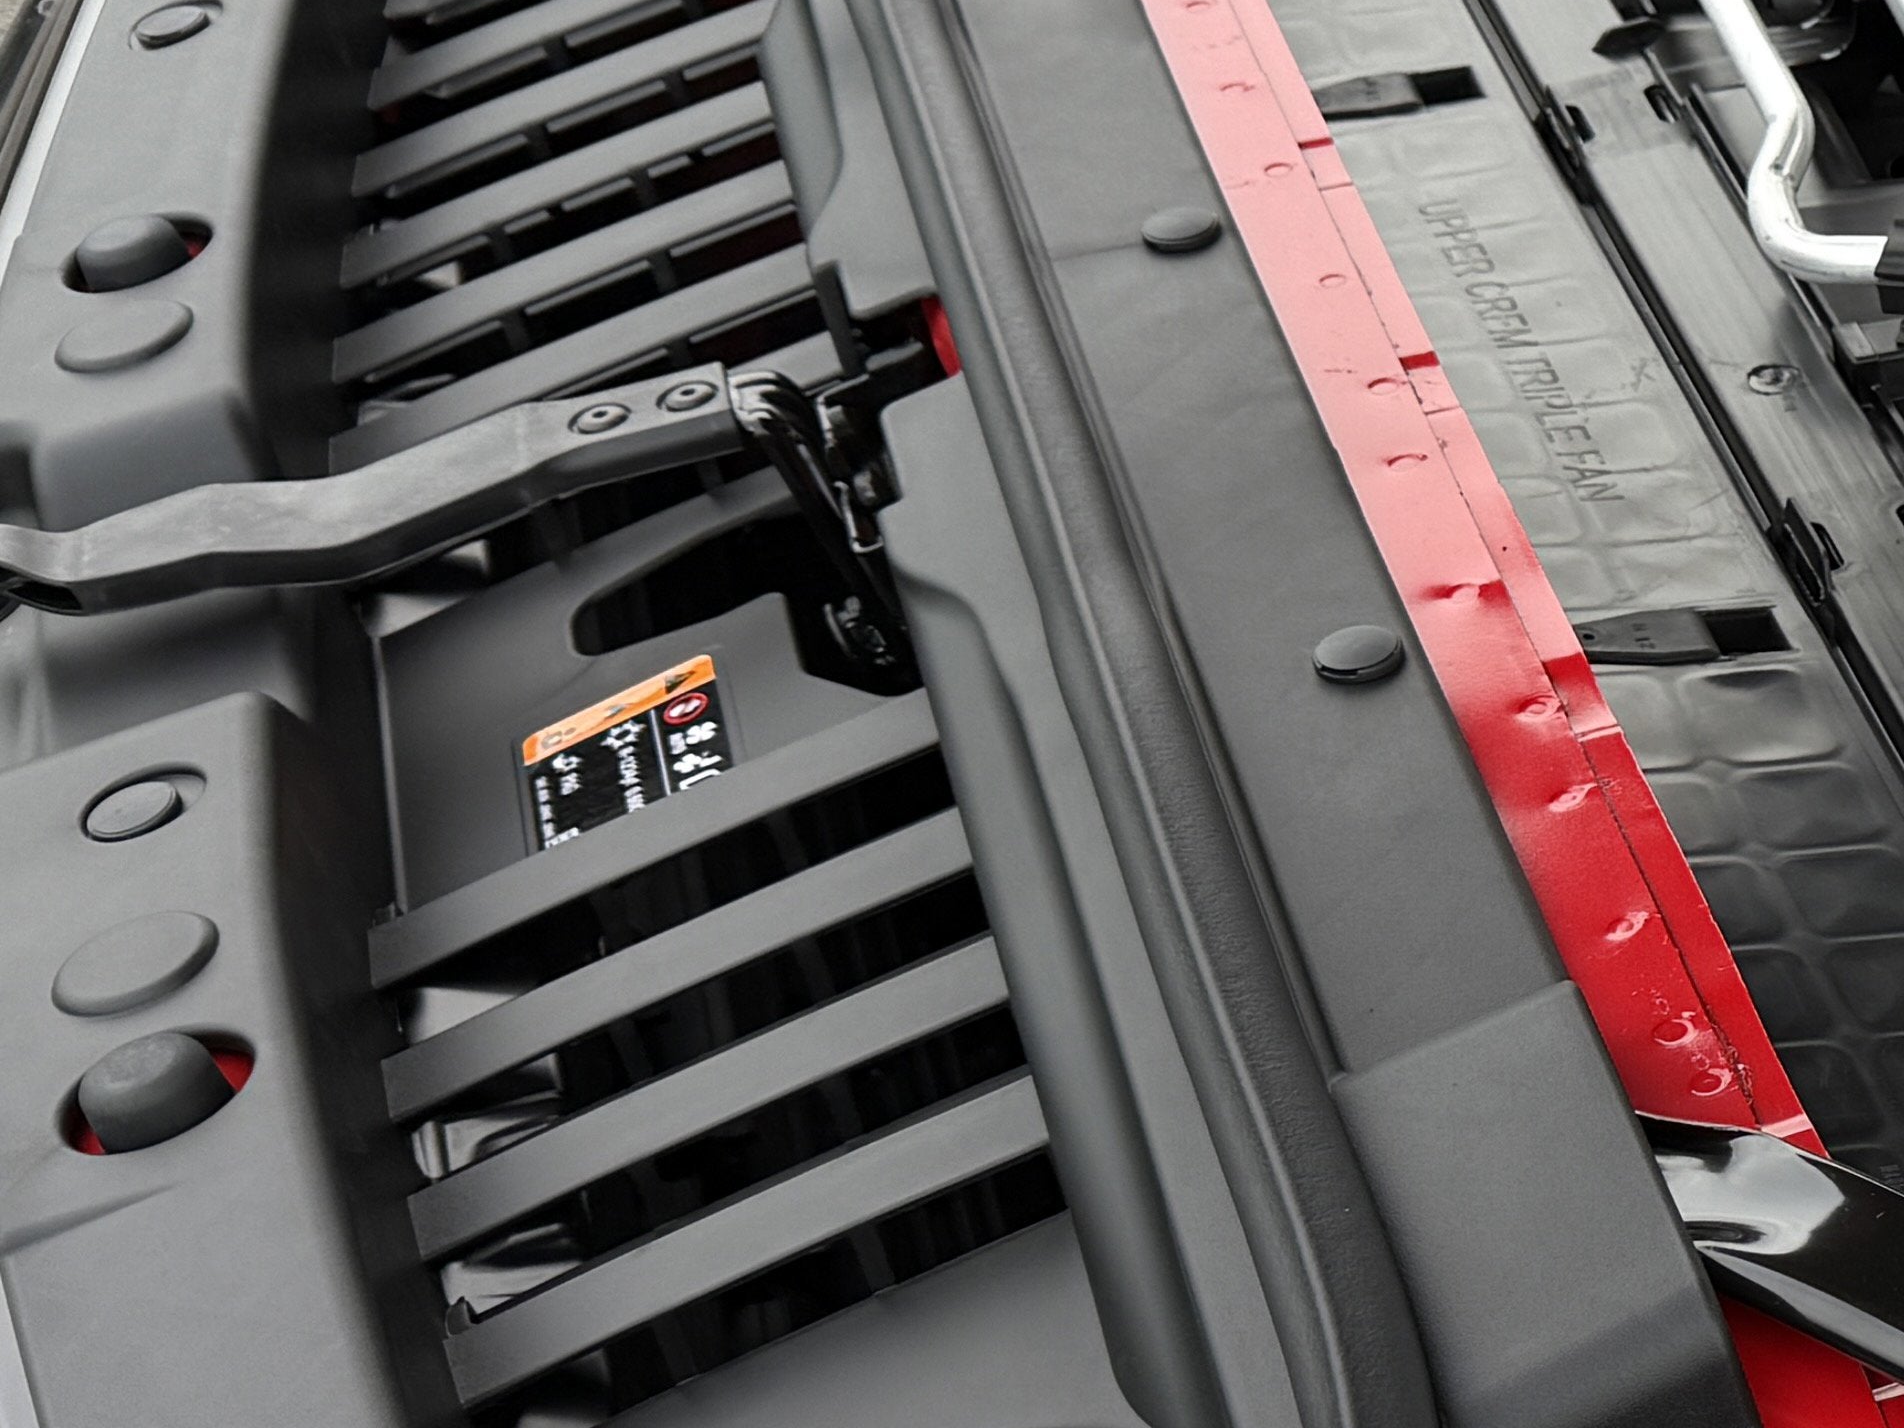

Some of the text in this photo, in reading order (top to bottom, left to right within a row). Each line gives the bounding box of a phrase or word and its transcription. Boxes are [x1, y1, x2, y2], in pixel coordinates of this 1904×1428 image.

[1418, 199, 1496, 278] UPPER
[1504, 351, 1594, 444] TRIPLE
[1555, 448, 1626, 503] FAN
